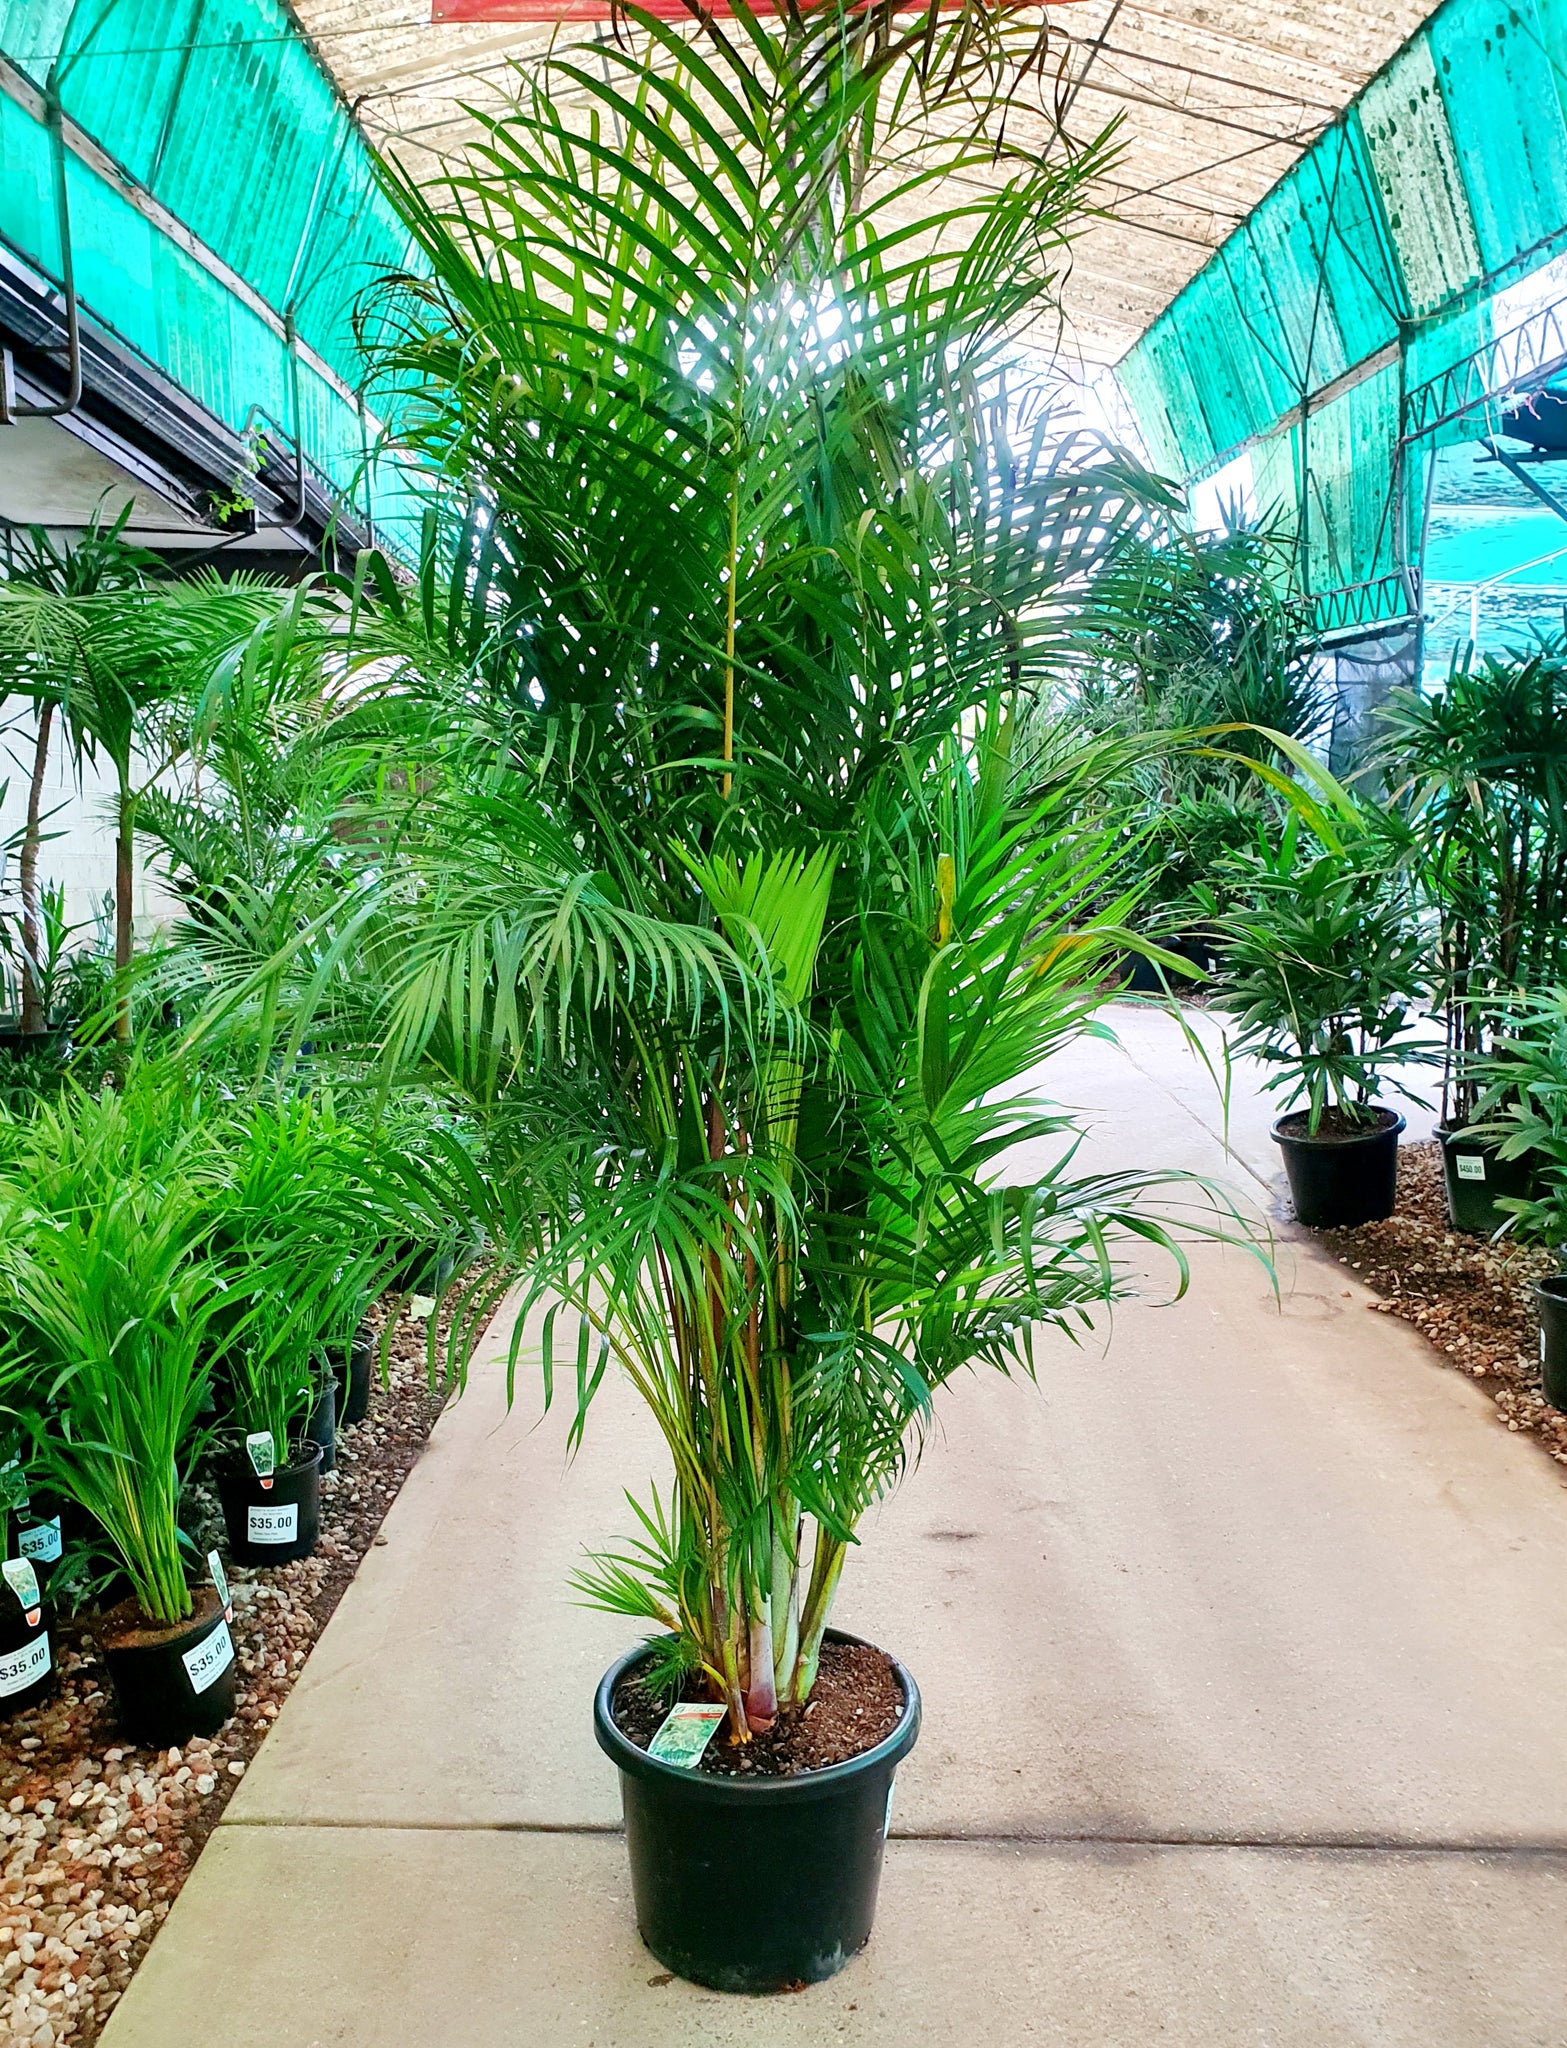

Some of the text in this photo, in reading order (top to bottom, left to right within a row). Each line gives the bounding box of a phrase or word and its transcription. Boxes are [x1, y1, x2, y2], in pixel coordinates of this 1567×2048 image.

[250, 1516, 292, 1529] $35.00
[21, 1530, 58, 1556] $35.00
[0, 1647, 45, 1680] $35.00
[189, 1636, 227, 1676] $35.00
